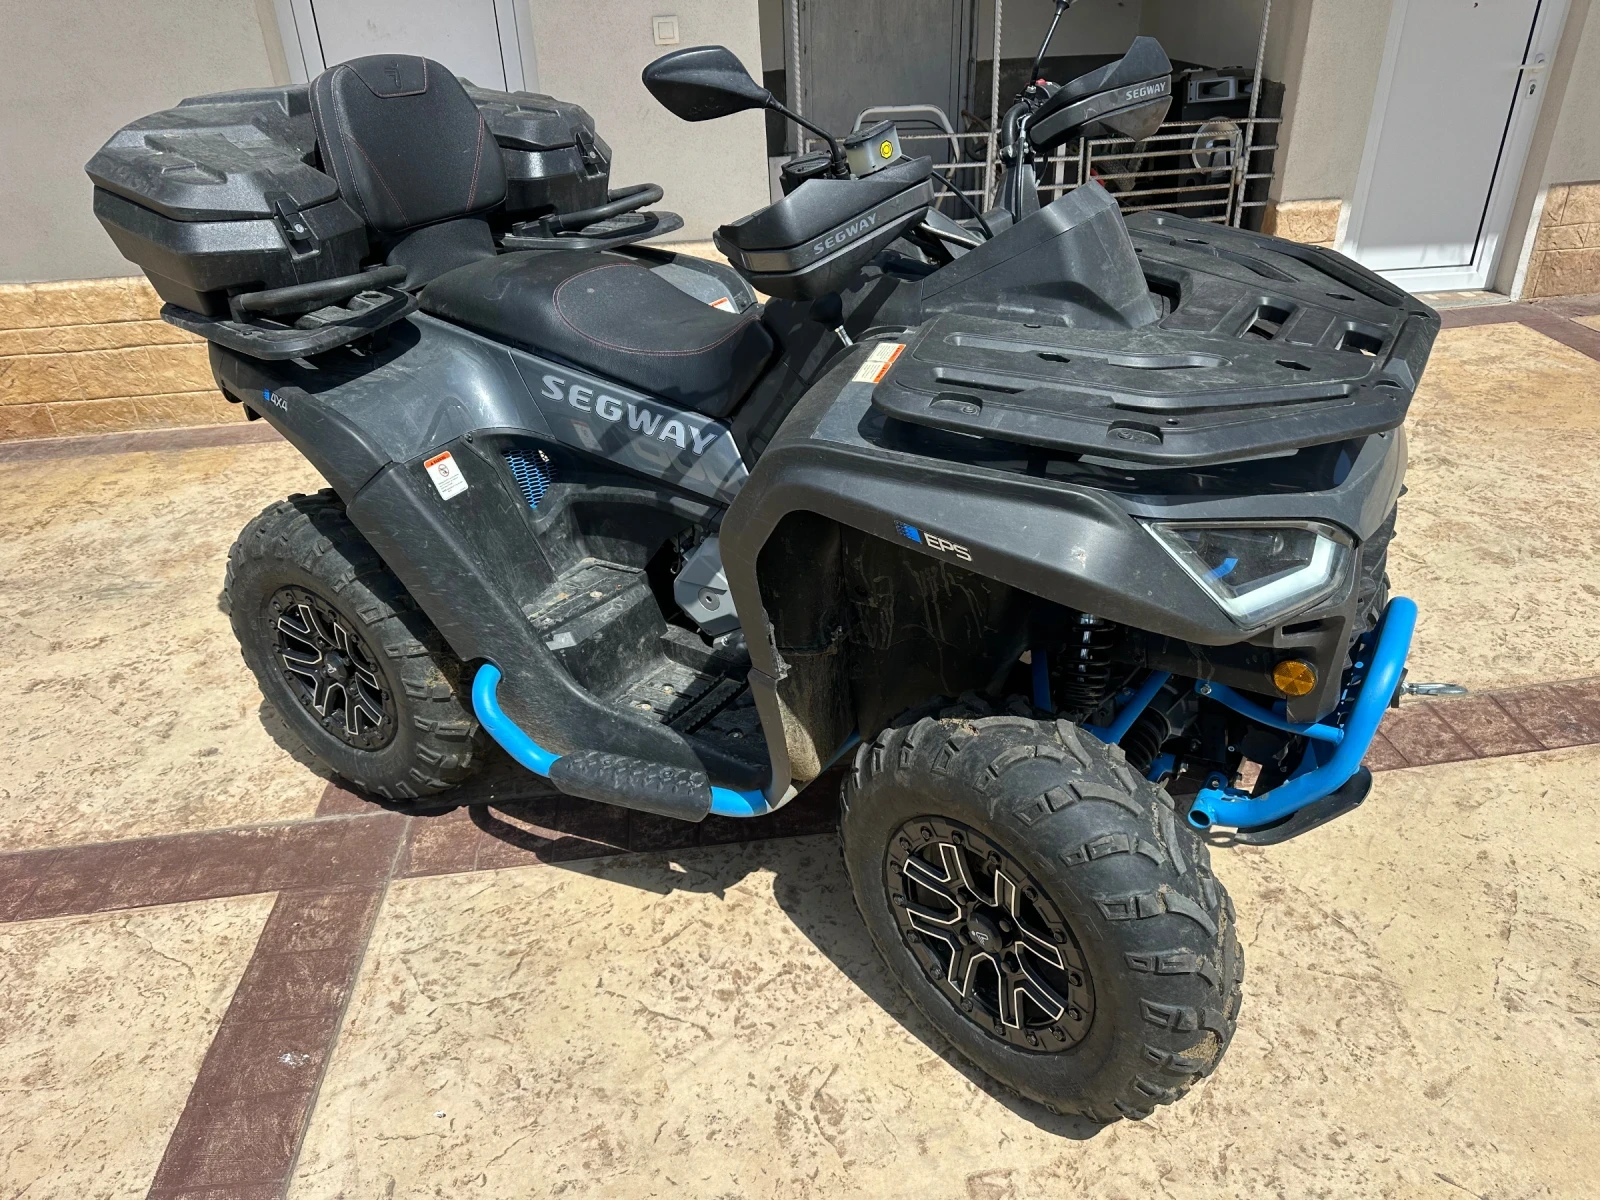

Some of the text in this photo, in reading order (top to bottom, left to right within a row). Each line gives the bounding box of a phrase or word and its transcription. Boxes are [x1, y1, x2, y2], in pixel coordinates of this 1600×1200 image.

[1125, 81, 1166, 101] SEGWAY
[813, 212, 877, 255] SEGWAY
[540, 374, 718, 456] SEGWAY
[923, 532, 973, 562] EPS
